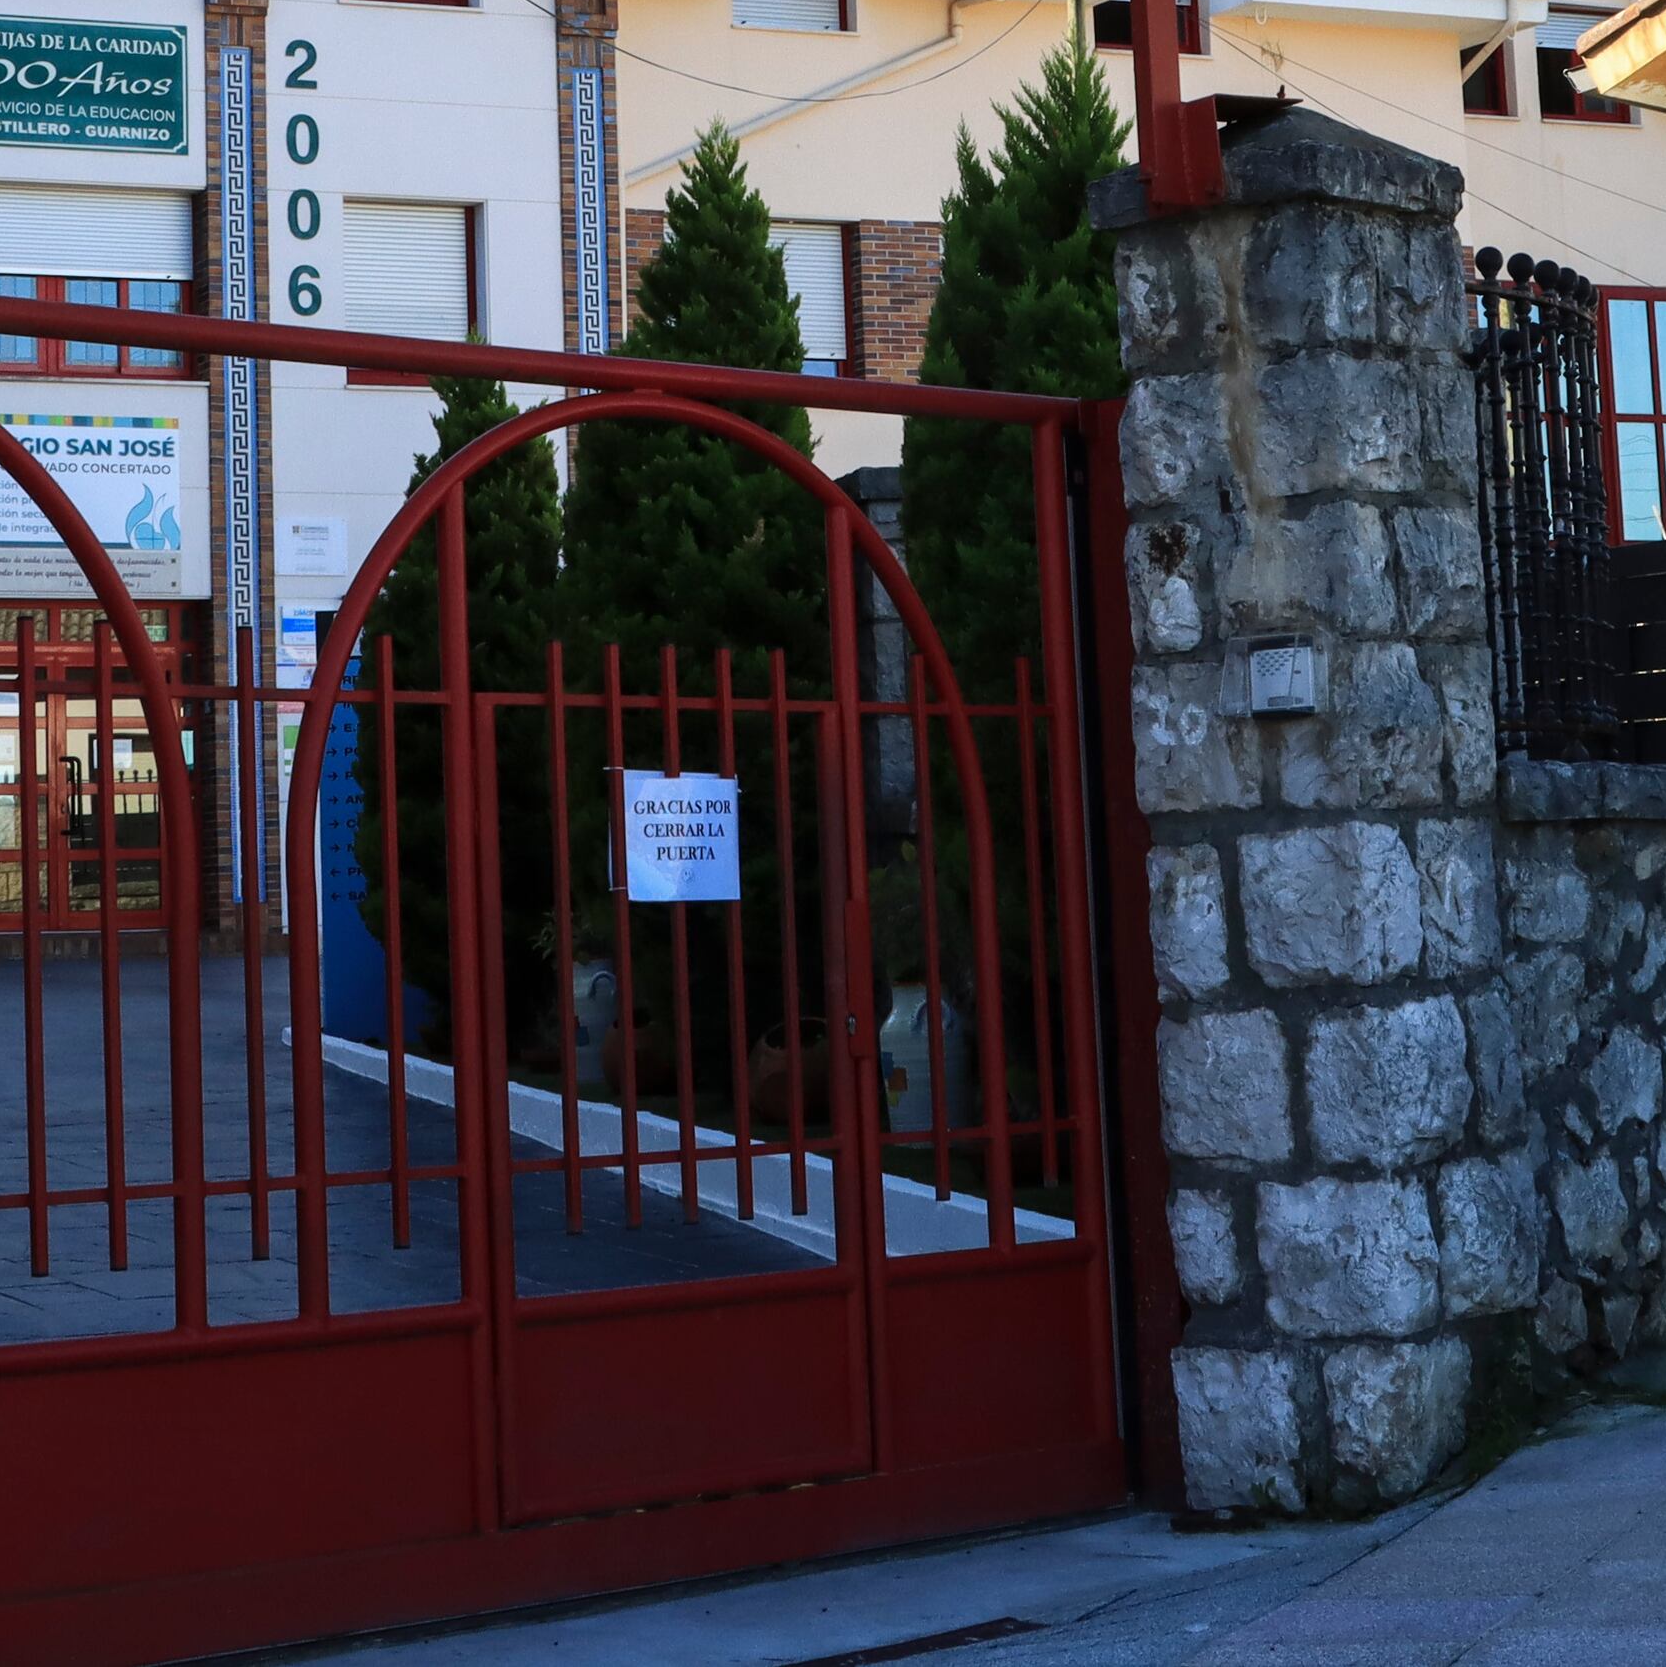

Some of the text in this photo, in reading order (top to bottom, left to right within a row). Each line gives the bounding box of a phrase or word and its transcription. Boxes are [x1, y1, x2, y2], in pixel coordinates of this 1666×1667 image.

[40, 34, 65, 50] DE
[69, 36, 92, 51] LA
[96, 37, 177, 57] CARIDAD
[57, 61, 173, 97] Años
[45, 103, 65, 117] DE
[69, 105, 87, 118] LA
[90, 105, 175, 122] EDUCACION
[85, 124, 170, 141] GUARNIZO
[65, 438, 112, 456] SAN
[119, 436, 175, 458] JOSÉ
[81, 463, 171, 475] CONCERTADO
[11, 523, 56, 535] integrac
[634, 799, 732, 815] GRACIAS POR
[643, 823, 725, 838] CERRAR LA
[656, 845, 716, 861] PUERTA
